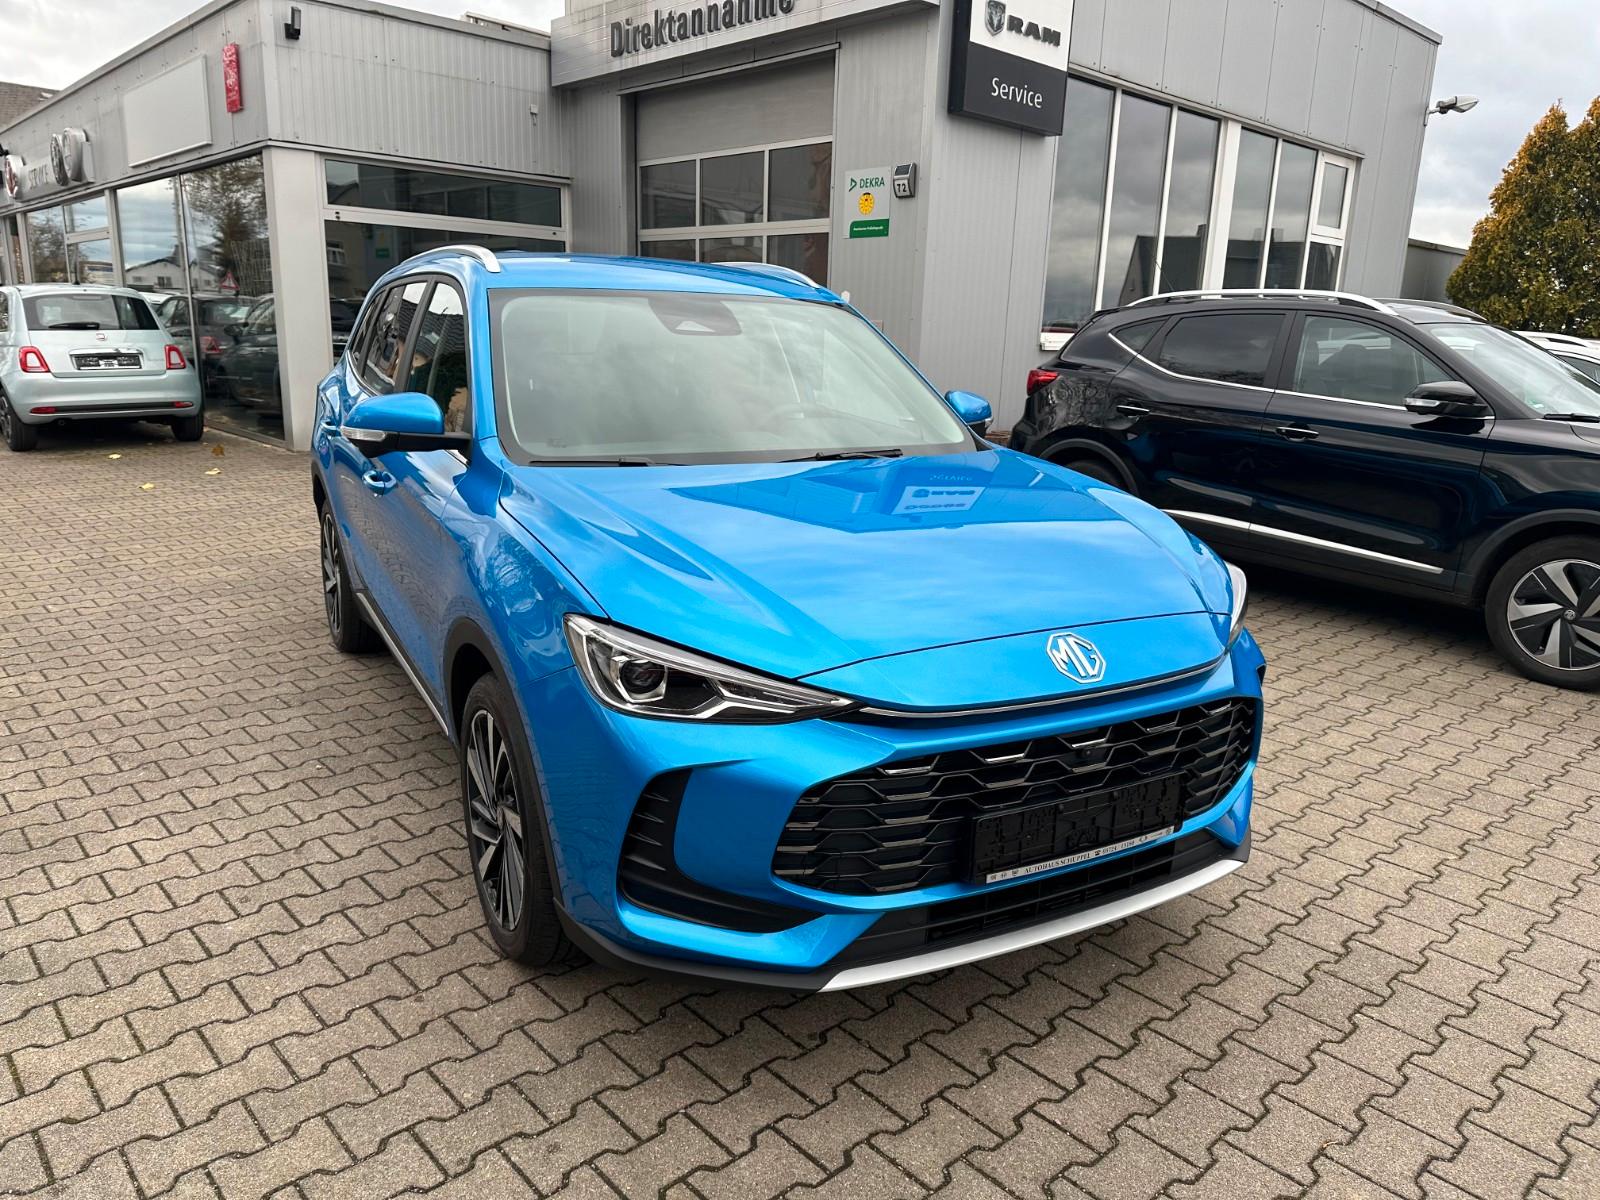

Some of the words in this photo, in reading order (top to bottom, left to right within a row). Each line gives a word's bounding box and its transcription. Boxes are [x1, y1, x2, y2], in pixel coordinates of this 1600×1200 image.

[1006, 14, 1062, 48] RAM
[991, 77, 1043, 109] Service
[859, 176, 885, 189] DEKRA
[1051, 636, 1101, 678] MG
